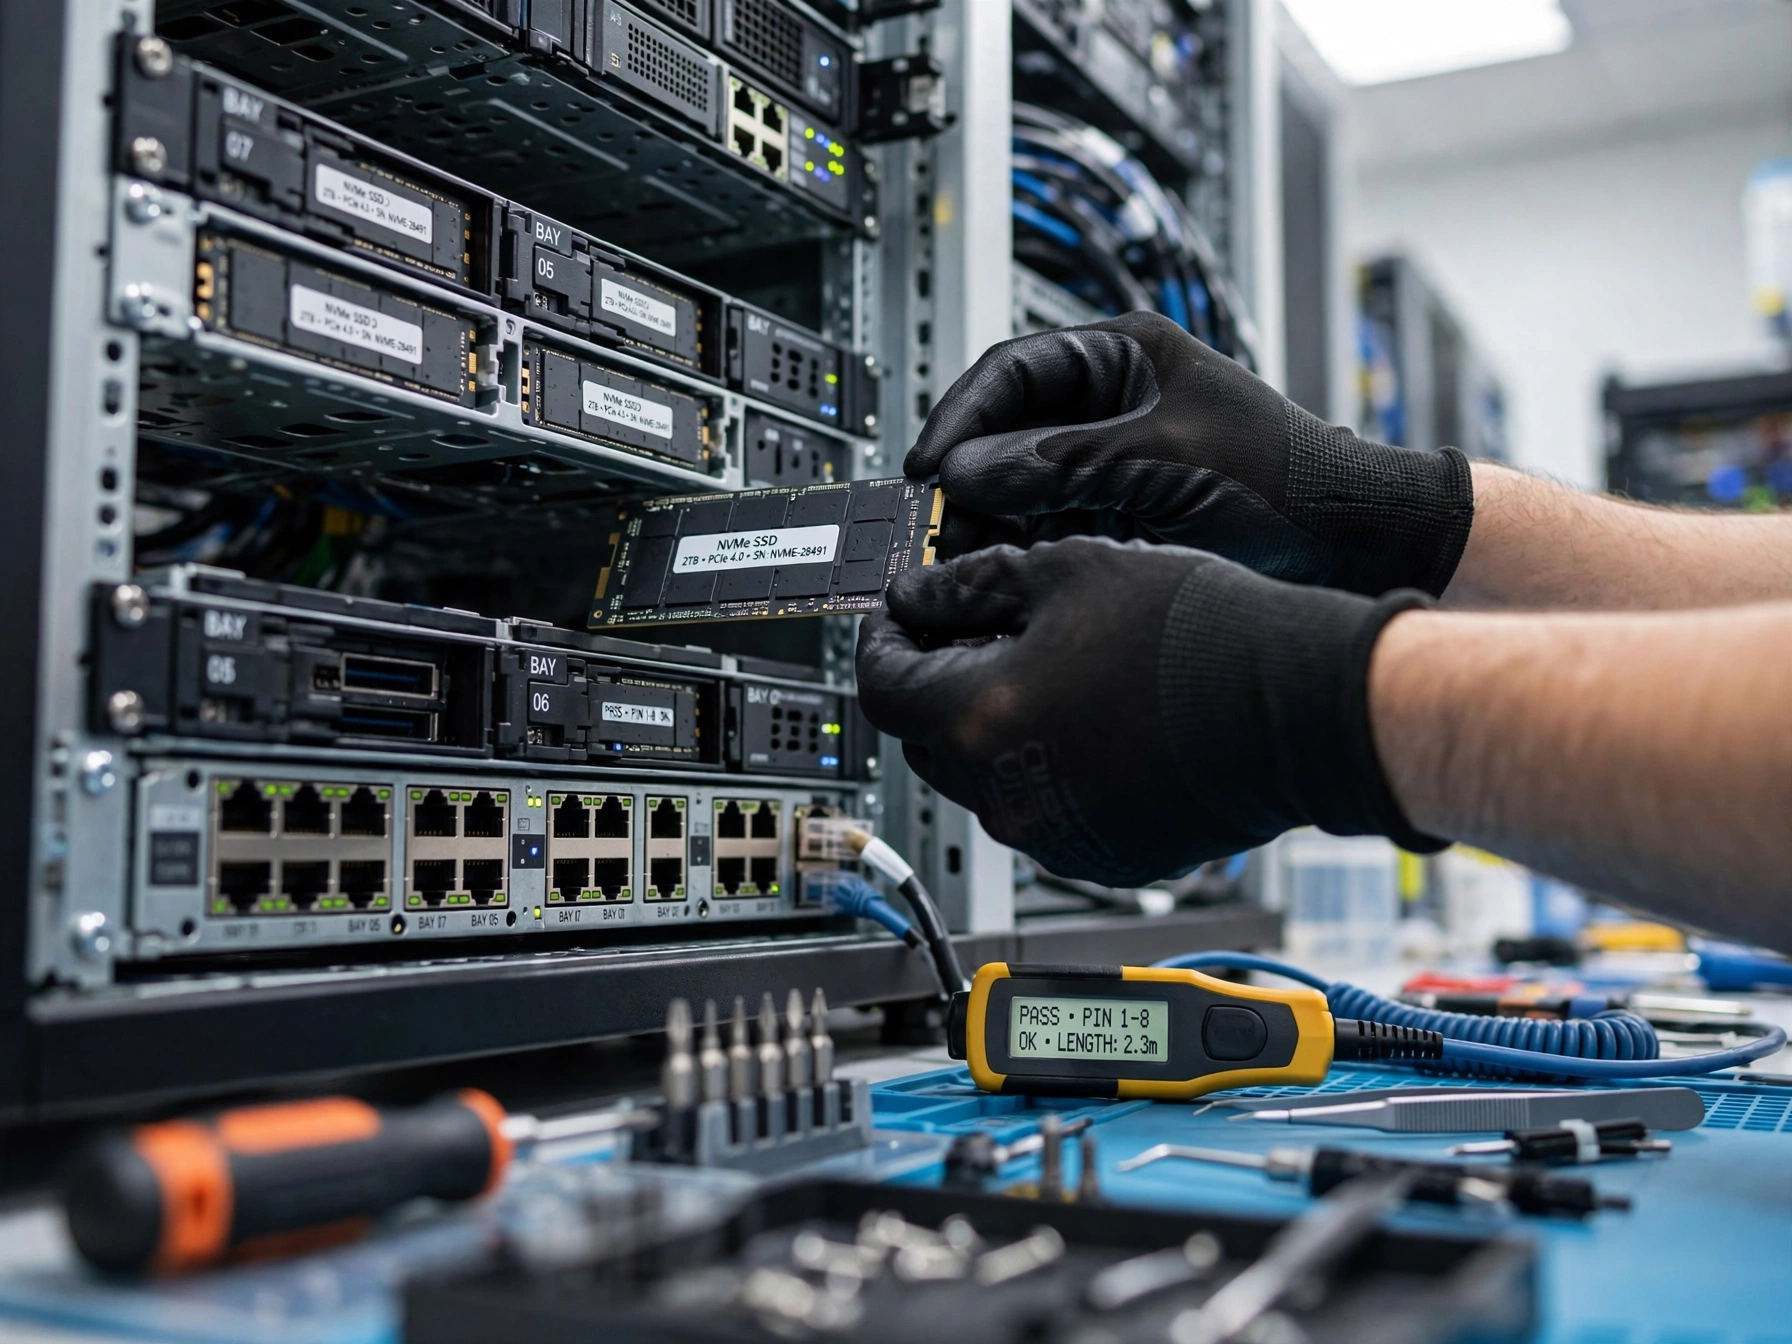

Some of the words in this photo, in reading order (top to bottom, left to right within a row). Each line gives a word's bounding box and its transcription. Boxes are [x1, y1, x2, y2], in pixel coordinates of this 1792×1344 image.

[223, 87, 264, 123] BAY
[226, 131, 254, 161] 07
[535, 221, 561, 247] BAY
[538, 257, 554, 279] 05
[716, 537, 751, 551] NVMe
[753, 535, 778, 547] SSD
[682, 556, 699, 567] 2TB
[708, 552, 728, 564] PCIe
[730, 551, 745, 562] 4.0
[769, 546, 828, 560] NVME-28491
[204, 609, 247, 640] BAY
[530, 655, 557, 678] BAY
[533, 692, 550, 712] 06
[418, 915, 436, 930] BAY
[471, 914, 487, 927] BAY
[559, 910, 574, 923] BAY
[603, 908, 617, 920] BAY
[1019, 1005, 1060, 1026] PASS
[1082, 1007, 1112, 1028] PIN
[1121, 1008, 1150, 1028] 1-8
[1019, 1031, 1037, 1051] OK
[1057, 1032, 1118, 1053] LENGTH:
[1124, 1034, 1158, 1055] 2.3m
